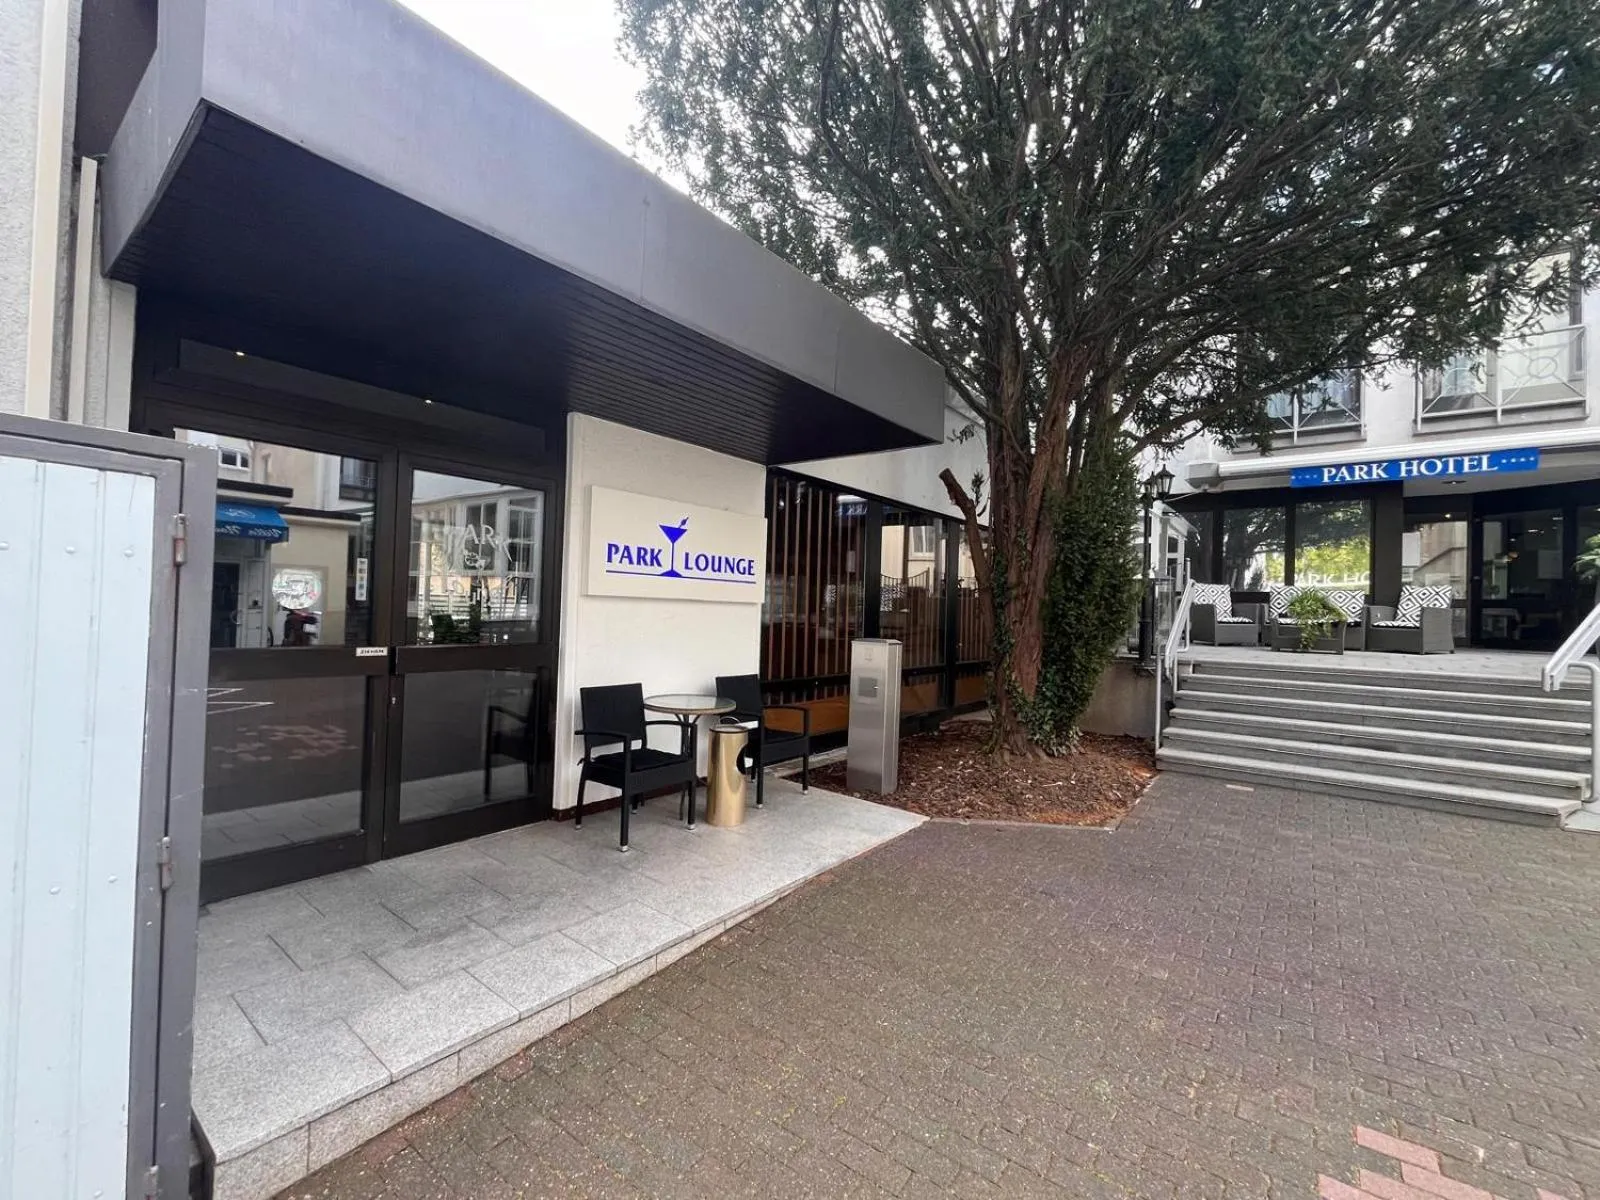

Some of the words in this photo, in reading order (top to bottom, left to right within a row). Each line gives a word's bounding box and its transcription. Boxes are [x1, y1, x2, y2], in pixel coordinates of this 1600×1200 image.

[1321, 462, 1389, 483] PARK
[1399, 454, 1498, 478] HOTEL
[606, 542, 663, 567] PARK
[684, 551, 756, 576] LOUNGE
[1295, 572, 1335, 585] ARK
